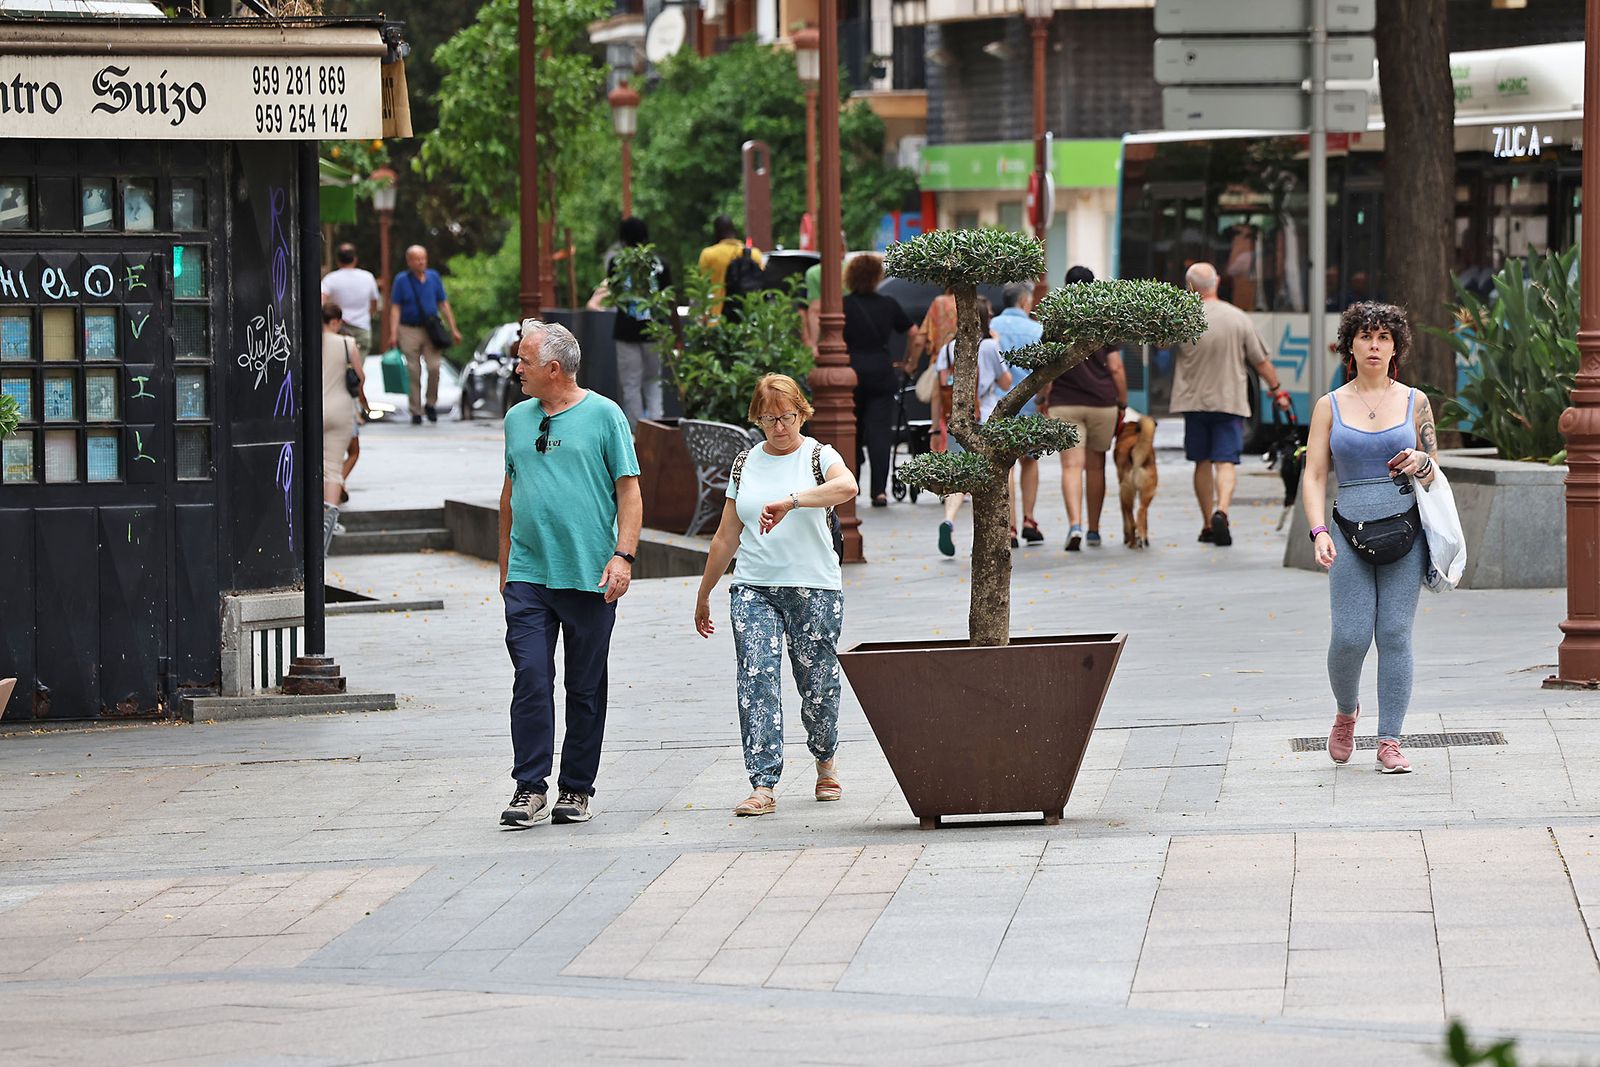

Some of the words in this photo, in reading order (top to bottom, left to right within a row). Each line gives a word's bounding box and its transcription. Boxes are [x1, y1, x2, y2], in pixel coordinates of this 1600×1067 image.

[252, 65, 279, 95] 959
[286, 65, 311, 95] 281
[319, 65, 345, 95] 869
[255, 104, 282, 133] 959
[289, 104, 316, 133] 254
[322, 104, 348, 133] 142
